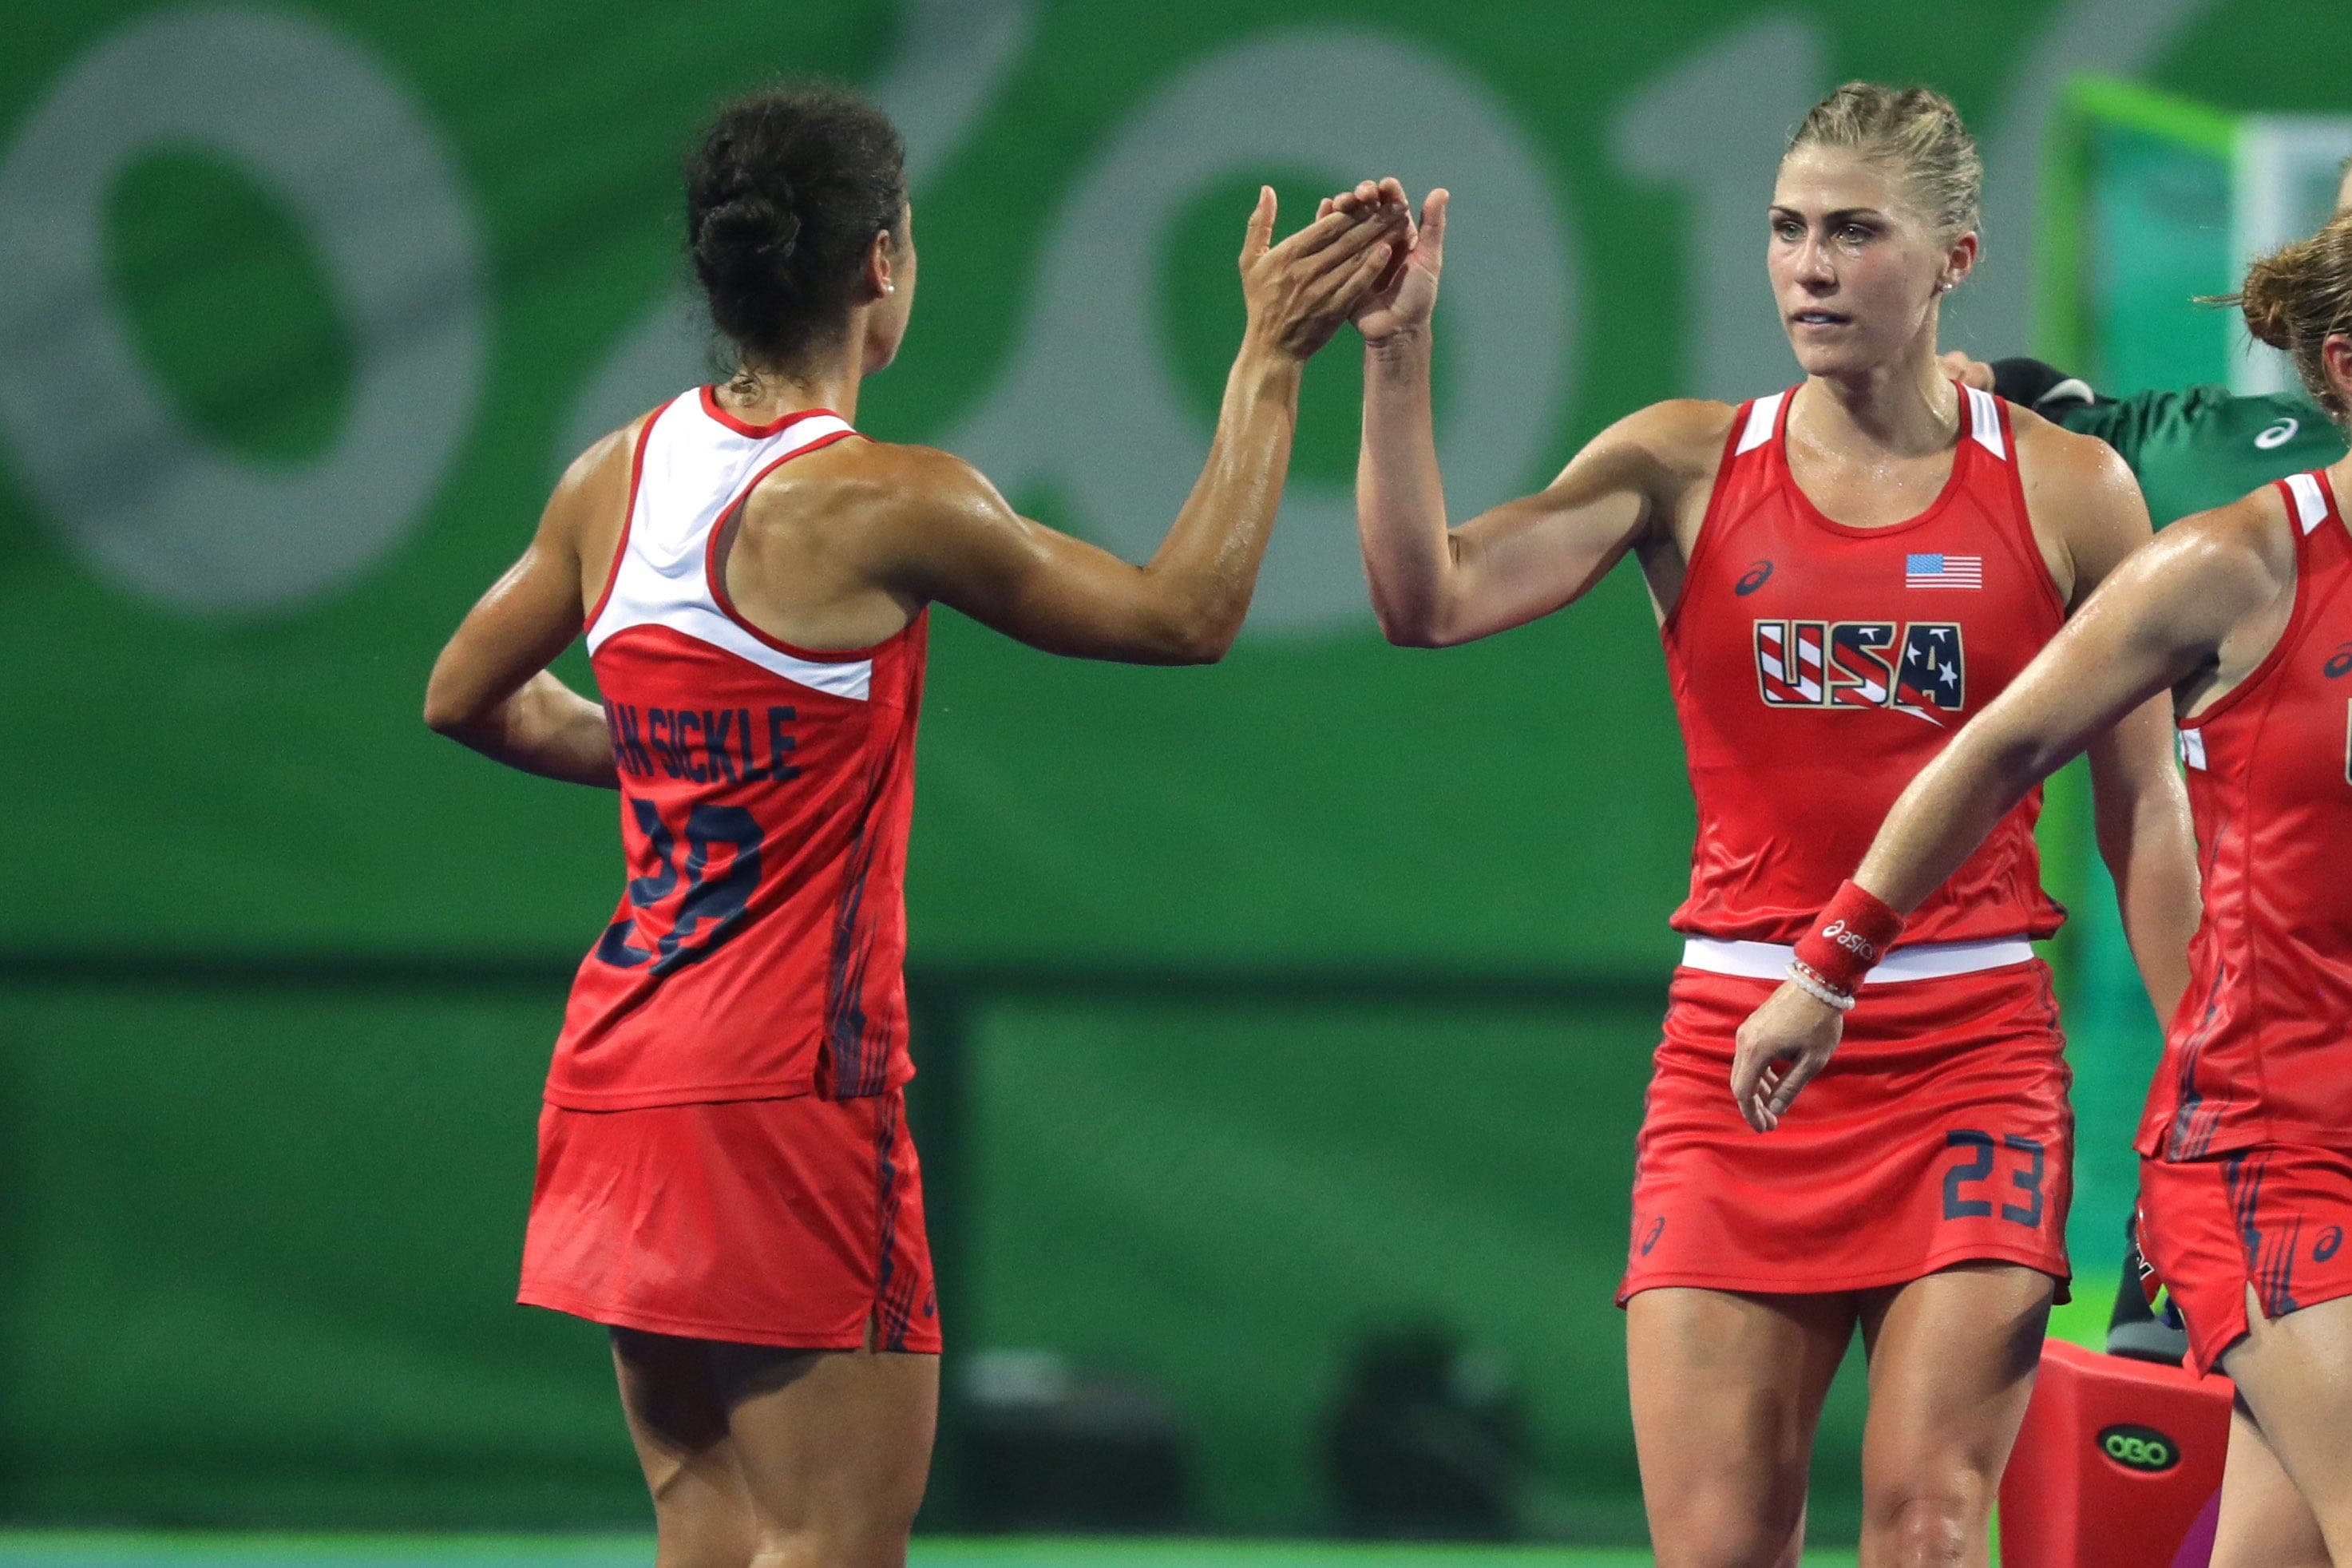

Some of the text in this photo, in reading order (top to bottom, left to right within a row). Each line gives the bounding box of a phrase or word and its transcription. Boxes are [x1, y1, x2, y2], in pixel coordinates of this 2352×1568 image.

[1753, 619, 1966, 723] USA
[648, 706, 802, 784] SICKLE
[1837, 931, 1875, 960] asic
[1942, 1129, 2044, 1228] 23
[2105, 1435, 2168, 1466] OBO
